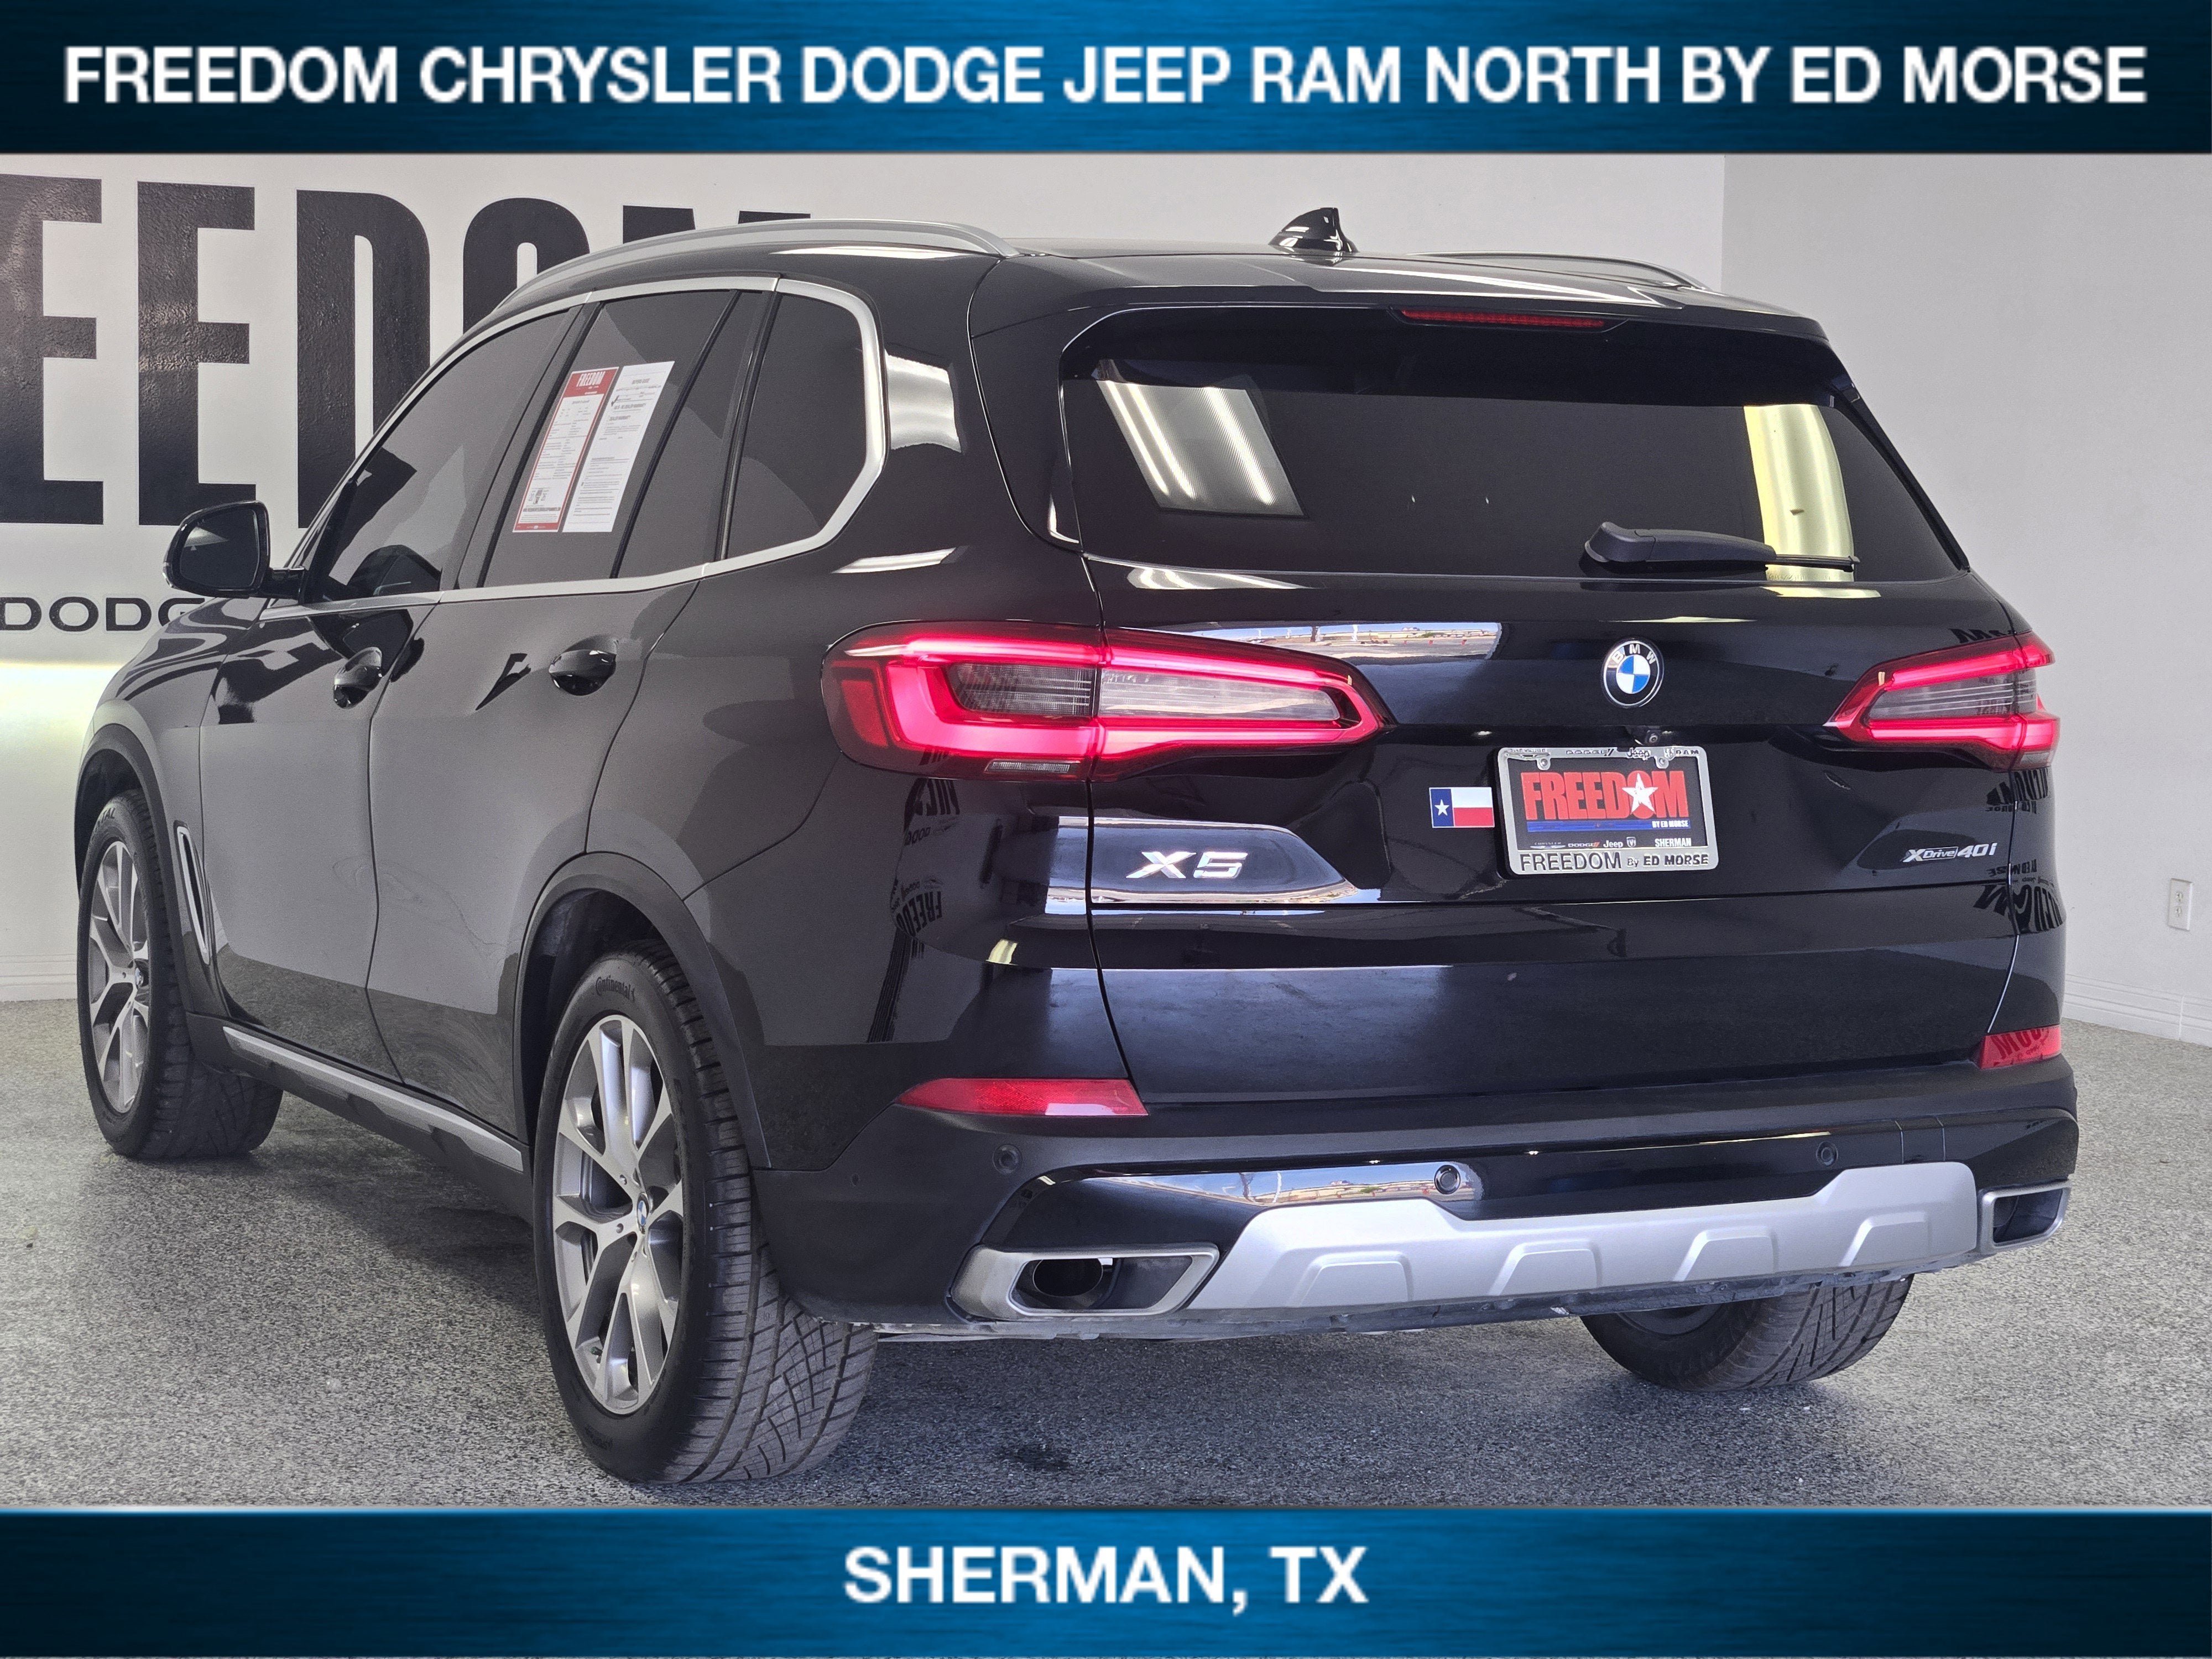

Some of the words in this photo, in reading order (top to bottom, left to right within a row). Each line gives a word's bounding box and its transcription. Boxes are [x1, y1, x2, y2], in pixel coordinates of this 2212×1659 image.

[576, 371, 606, 387] FREEDOM
[1611, 643, 1657, 665] BMW
[1521, 770, 1689, 820] FREEDOM
[1603, 840, 1624, 848] Jeep
[1655, 838, 1692, 848] SHERMAN
[1125, 851, 1249, 879] X5
[1520, 851, 1622, 872] FREEDOM
[1643, 855, 1660, 867] ED
[1664, 854, 1709, 867] MORSE
[596, 975, 632, 1000] Continental
